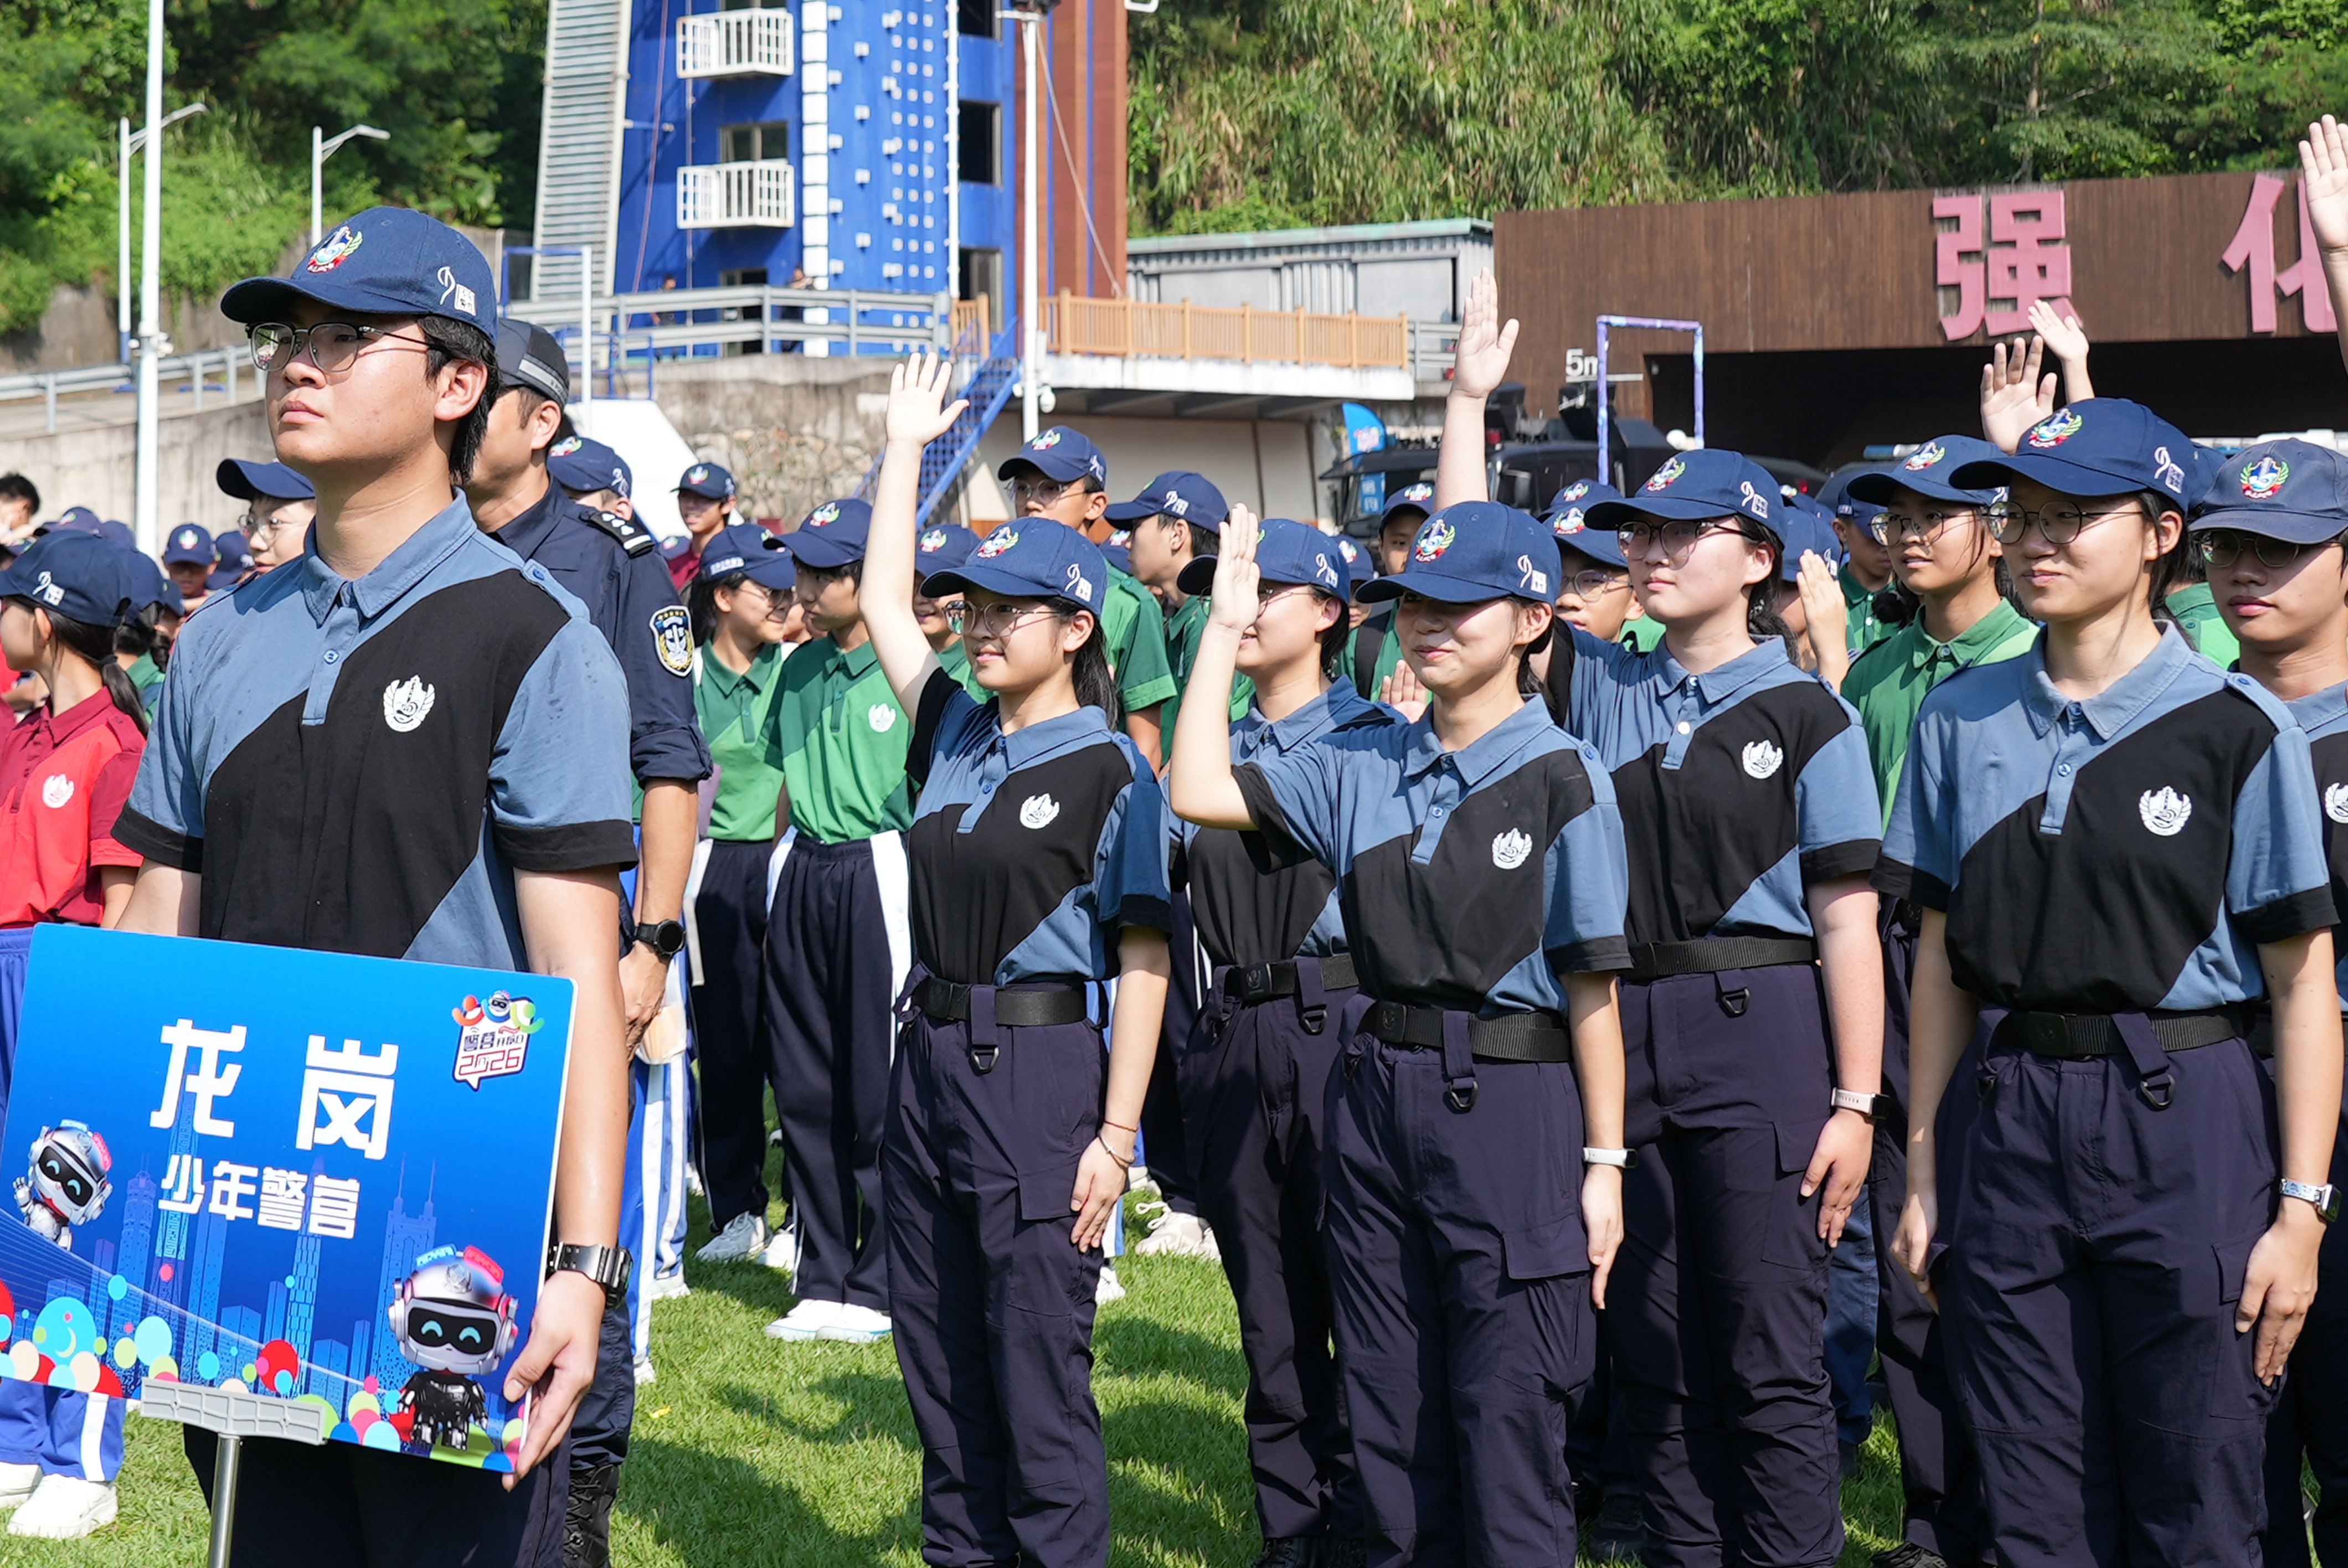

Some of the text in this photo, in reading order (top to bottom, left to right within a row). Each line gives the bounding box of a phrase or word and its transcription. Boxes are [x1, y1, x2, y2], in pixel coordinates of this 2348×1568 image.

[150, 1018, 399, 1160] 龙岗
[459, 1047, 522, 1076] 2026
[158, 1153, 360, 1240] 少年警营
